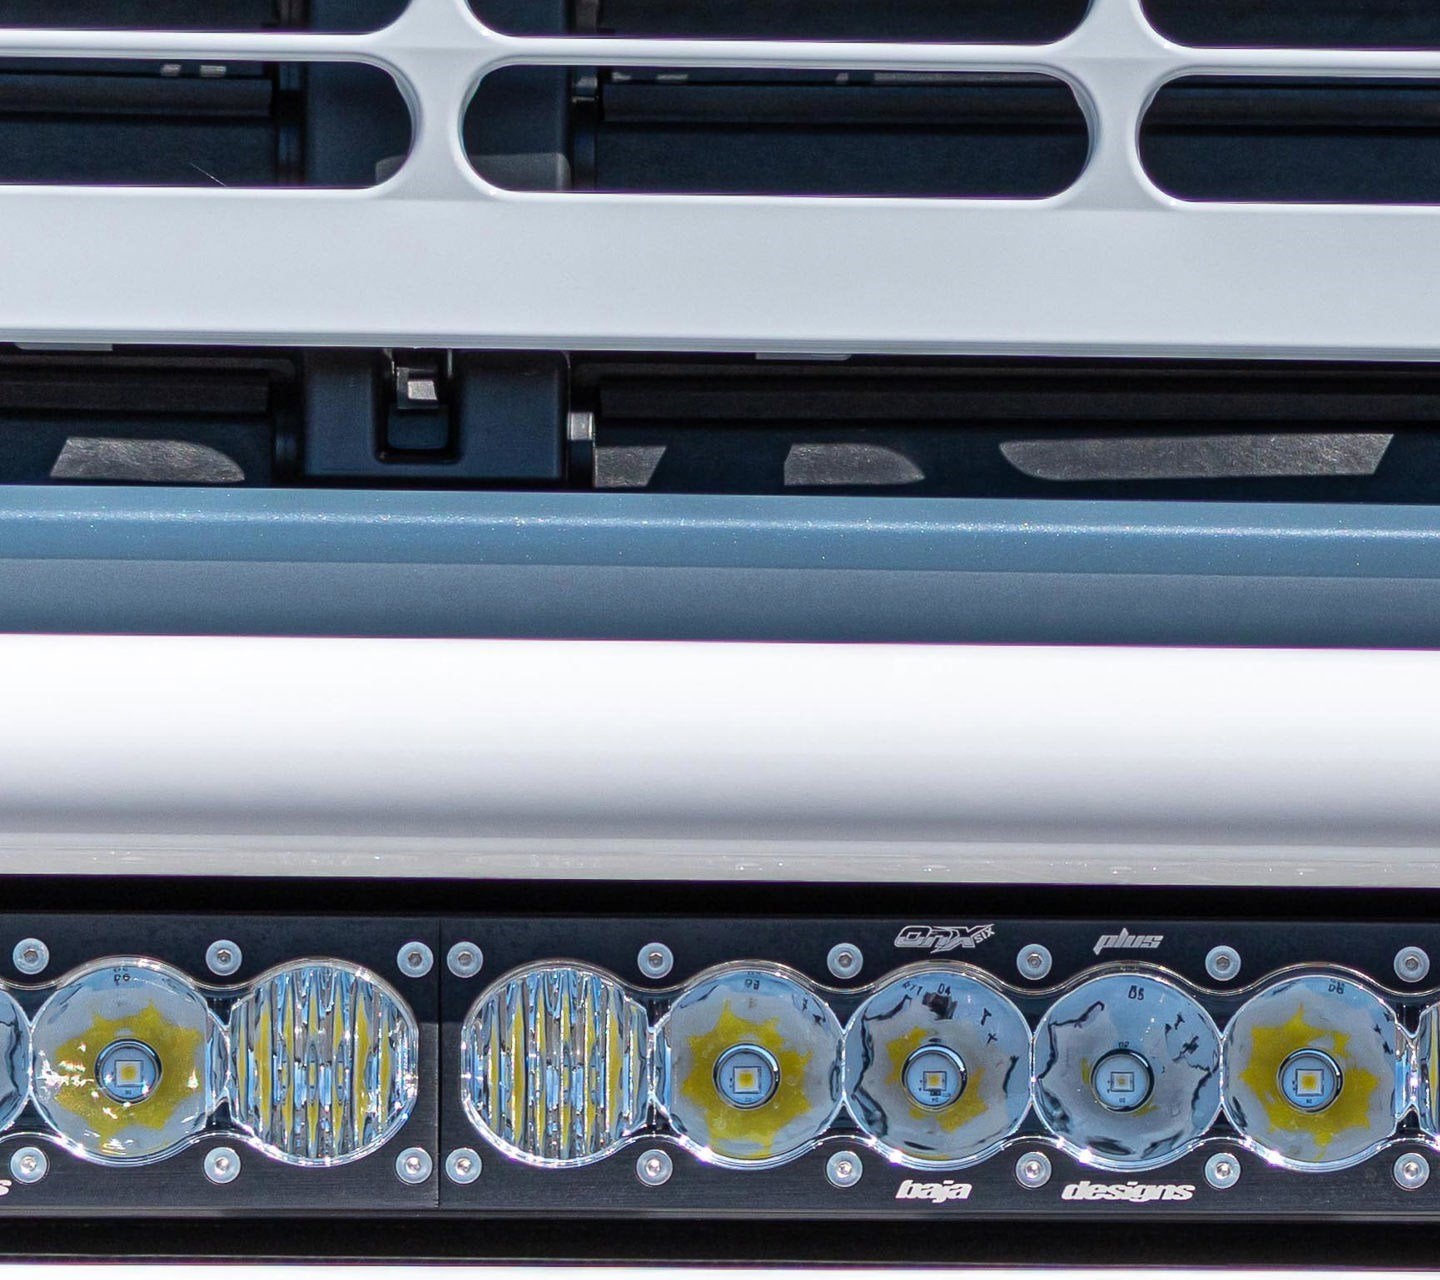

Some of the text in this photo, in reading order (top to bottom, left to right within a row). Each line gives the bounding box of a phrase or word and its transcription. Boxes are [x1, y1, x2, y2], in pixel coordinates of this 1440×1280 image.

[1093, 927, 1164, 955] plus
[896, 1180, 1195, 1203] baja designs
